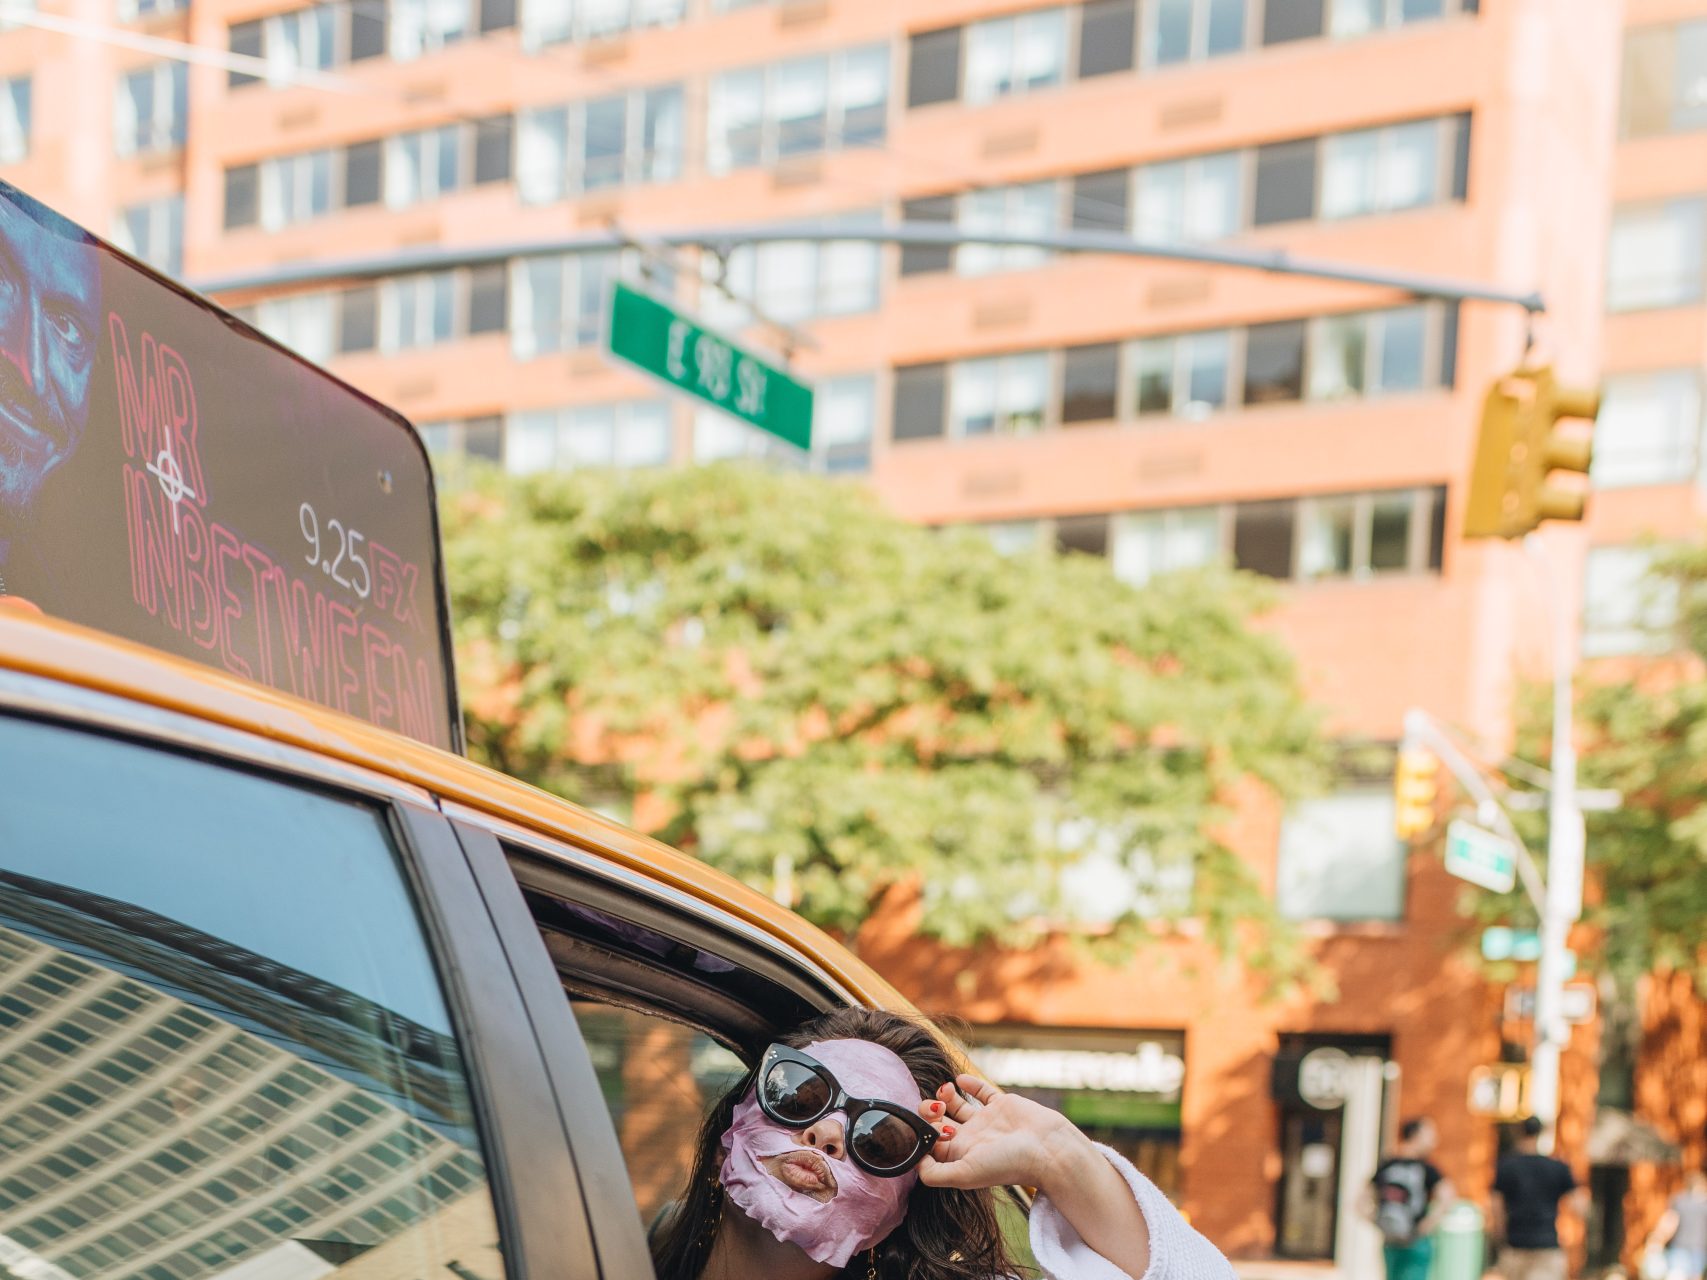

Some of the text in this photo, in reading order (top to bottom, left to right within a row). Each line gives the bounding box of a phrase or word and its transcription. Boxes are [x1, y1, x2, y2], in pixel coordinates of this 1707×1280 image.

[108, 311, 208, 507] MR
[299, 502, 425, 633] 9.25 FX
